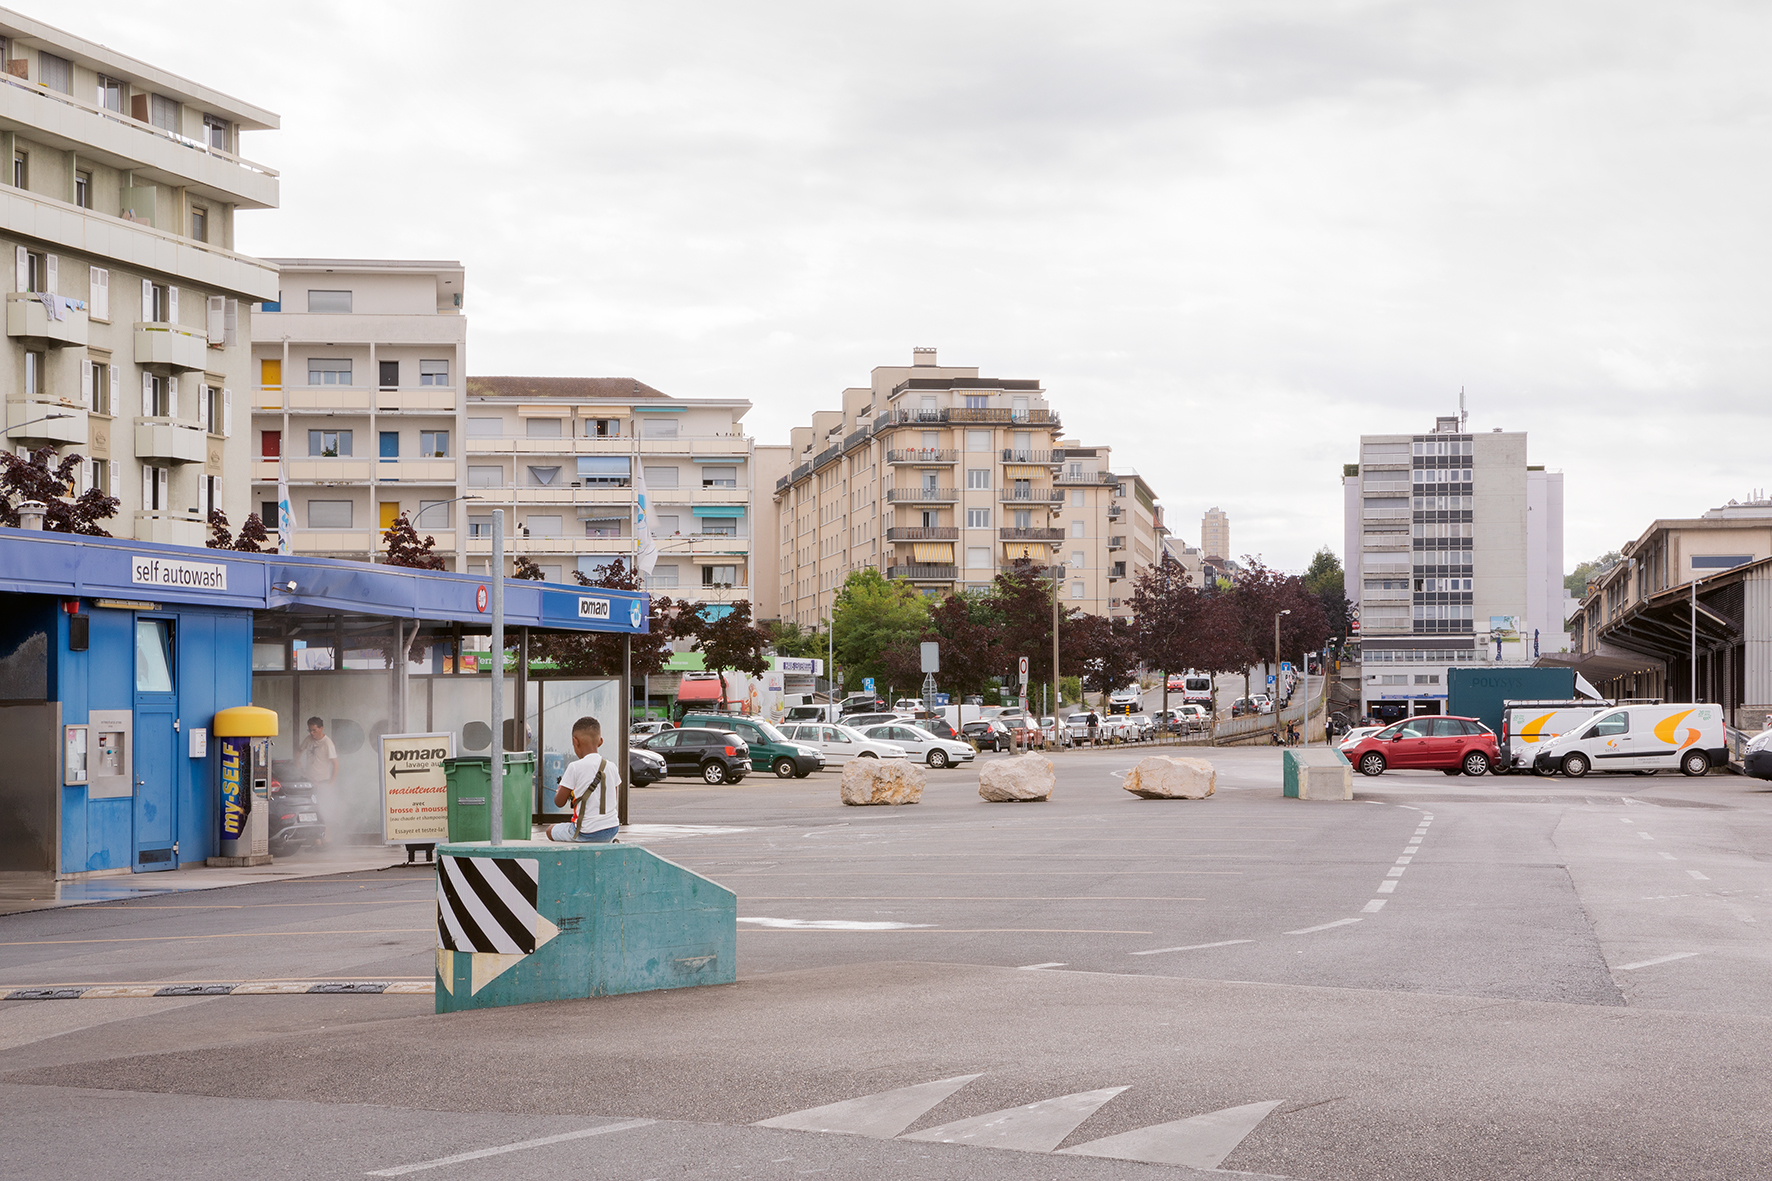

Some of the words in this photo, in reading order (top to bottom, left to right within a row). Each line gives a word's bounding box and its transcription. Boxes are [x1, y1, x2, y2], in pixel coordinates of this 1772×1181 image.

[136, 560, 159, 582] self
[163, 565, 223, 588] autowash
[580, 600, 608, 616] romaro
[389, 748, 446, 761] romaro
[406, 761, 429, 769] lavage
[430, 760, 442, 768] au
[223, 741, 241, 833] my-SELF
[389, 785, 447, 794] maintenant
[415, 806, 420, 814] à
